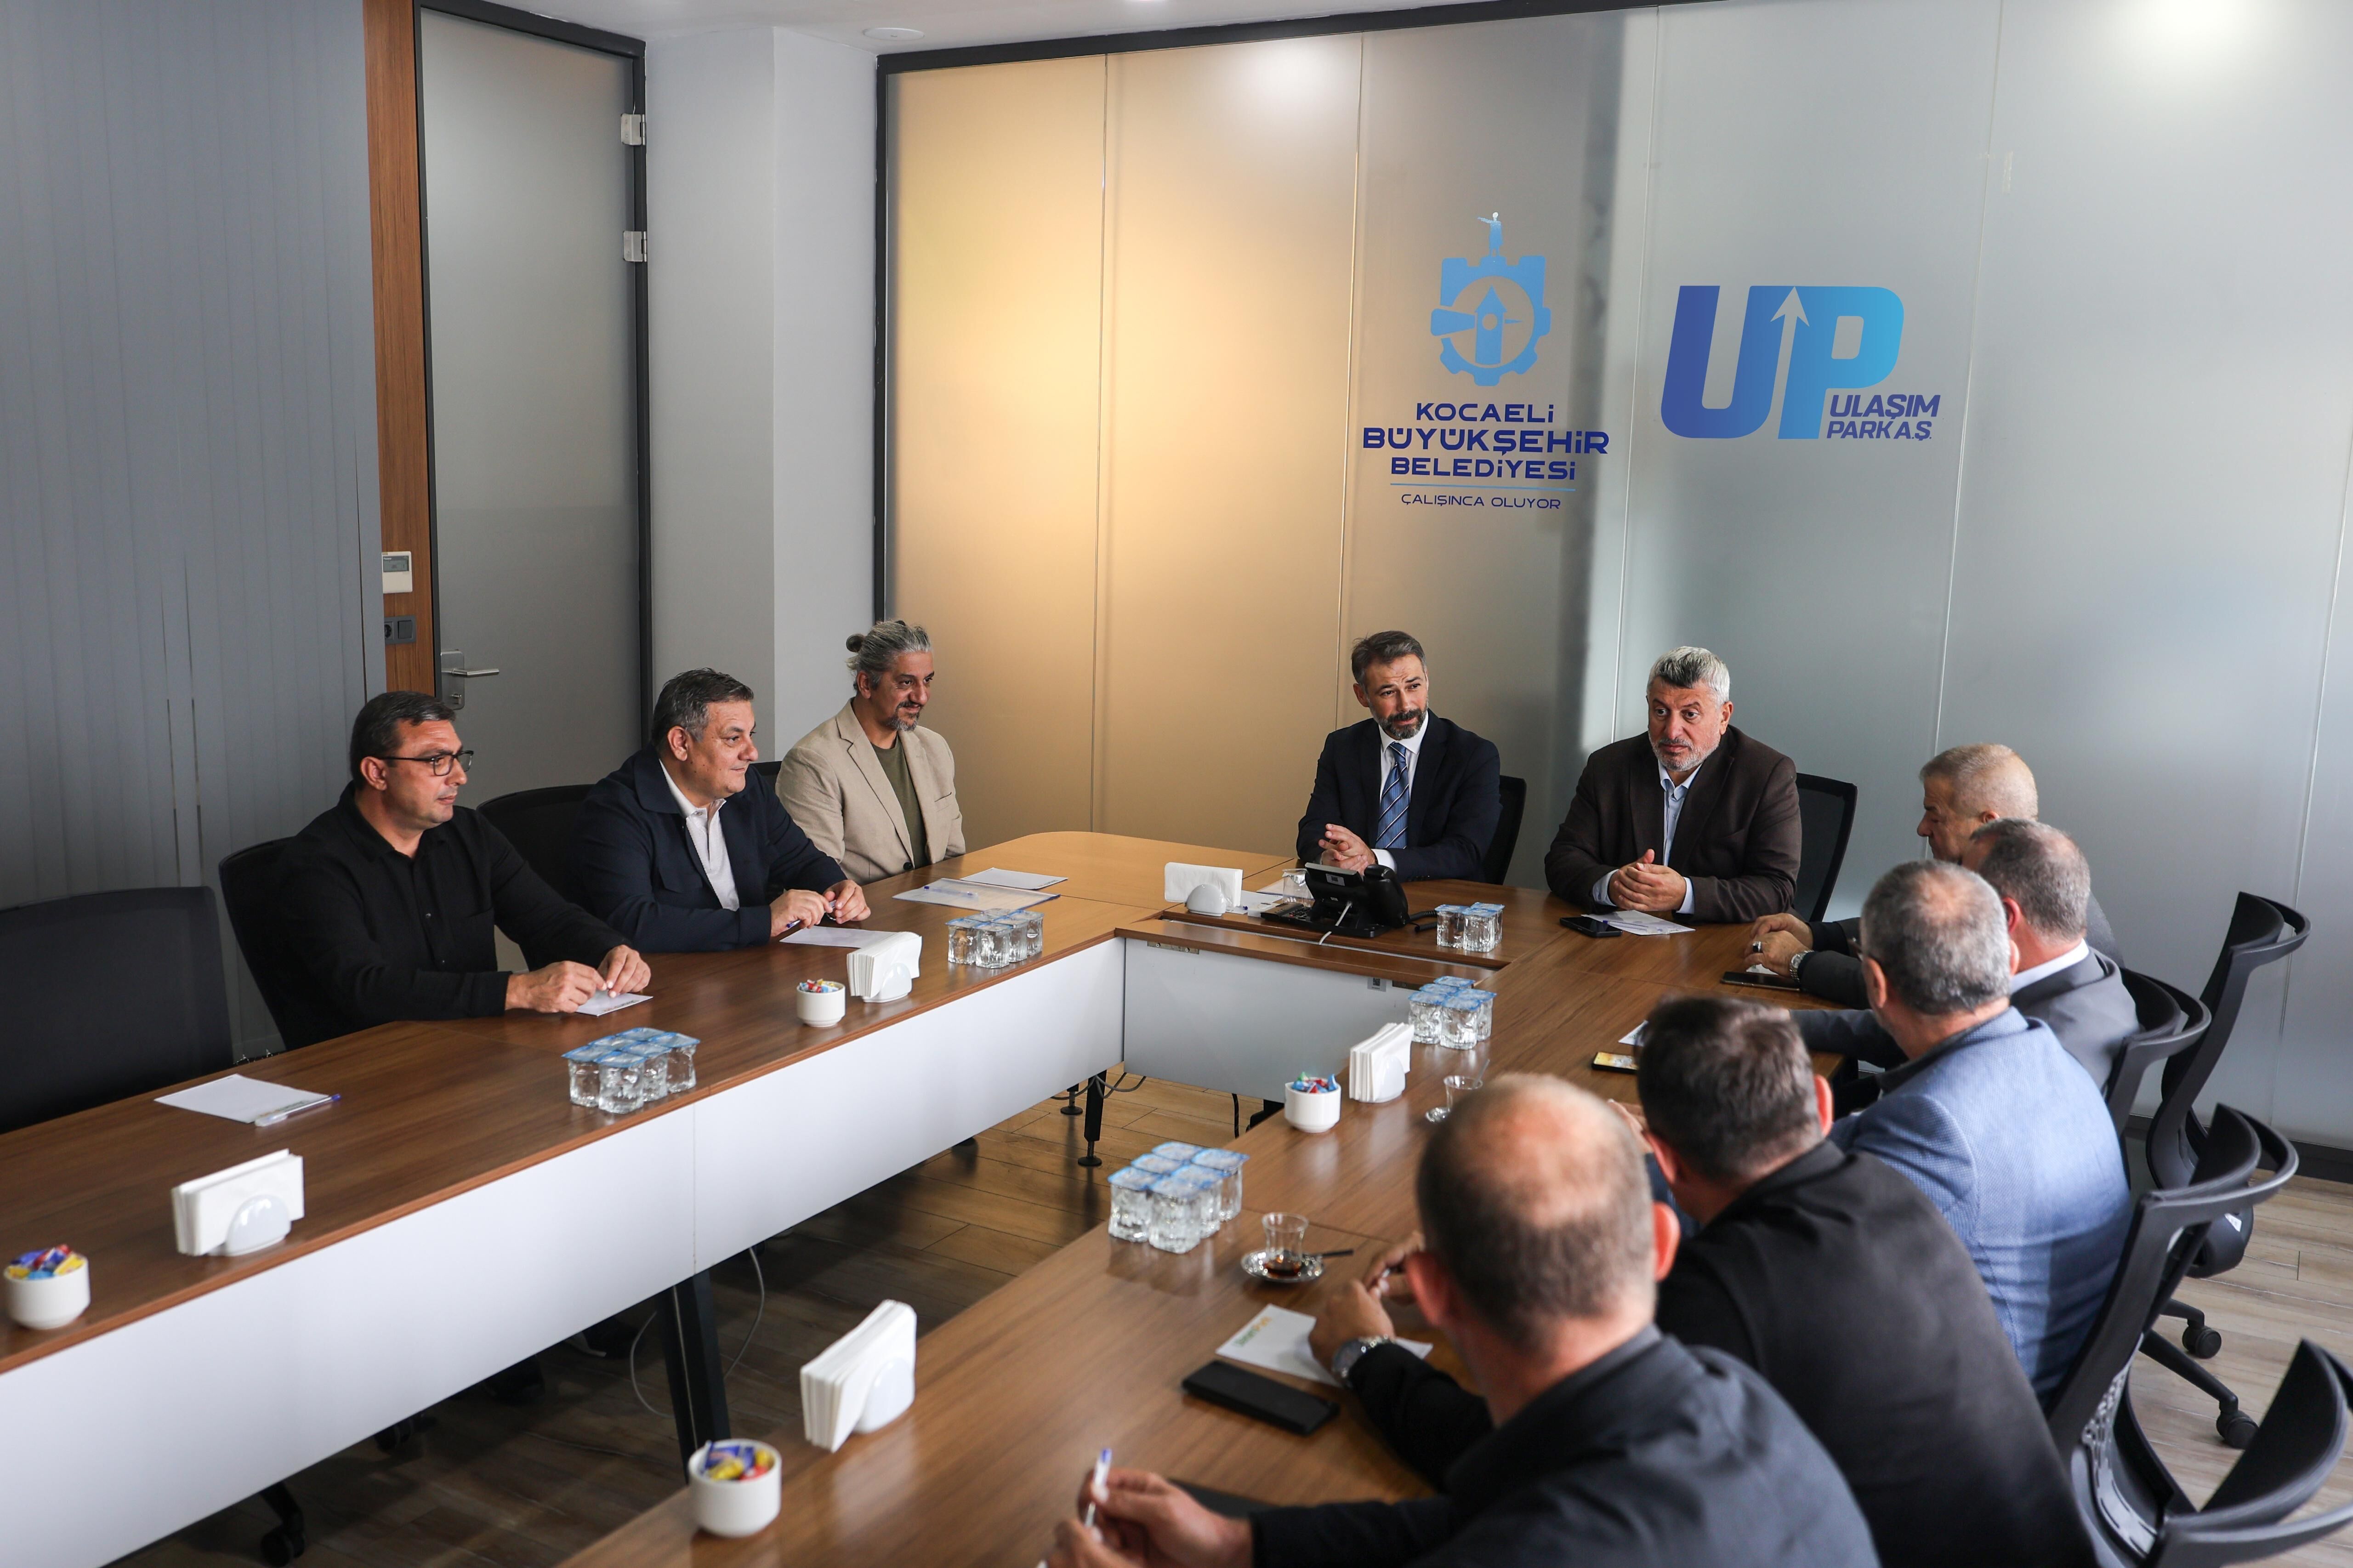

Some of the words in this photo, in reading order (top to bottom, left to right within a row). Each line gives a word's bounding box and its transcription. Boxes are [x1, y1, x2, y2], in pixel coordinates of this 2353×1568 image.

[1660, 285, 1904, 439] UP
[1830, 394, 1941, 419] ULAŞIM
[1401, 494, 1484, 506] ÇALIŞINCA
[1491, 497, 1561, 509] OLUYOR
